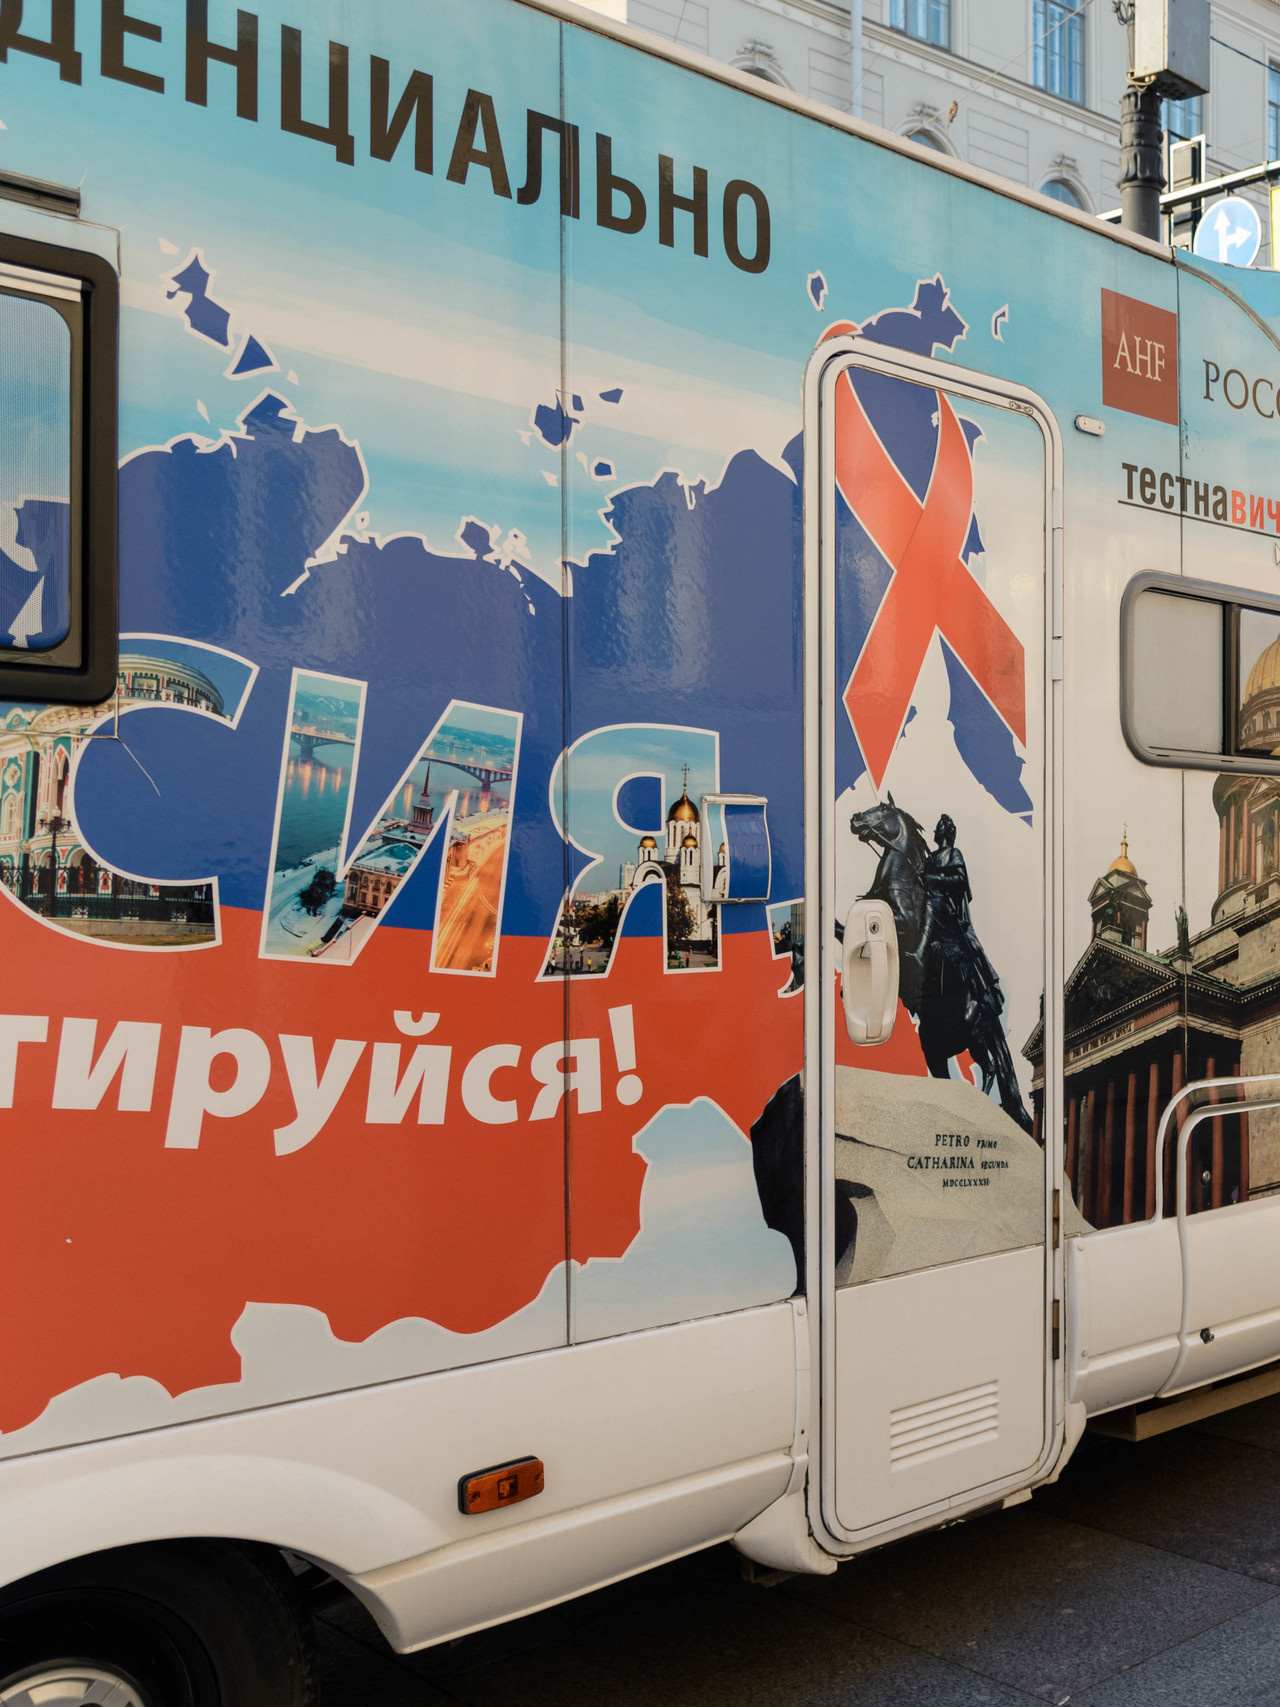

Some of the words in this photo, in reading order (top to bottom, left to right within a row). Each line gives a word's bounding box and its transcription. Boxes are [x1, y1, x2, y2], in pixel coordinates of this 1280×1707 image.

[935, 1134, 970, 1147] PETRO
[976, 1140, 998, 1149] PRIMO
[907, 1156, 975, 1169] CATHARINA
[981, 1160, 1009, 1169] SECUNDA
